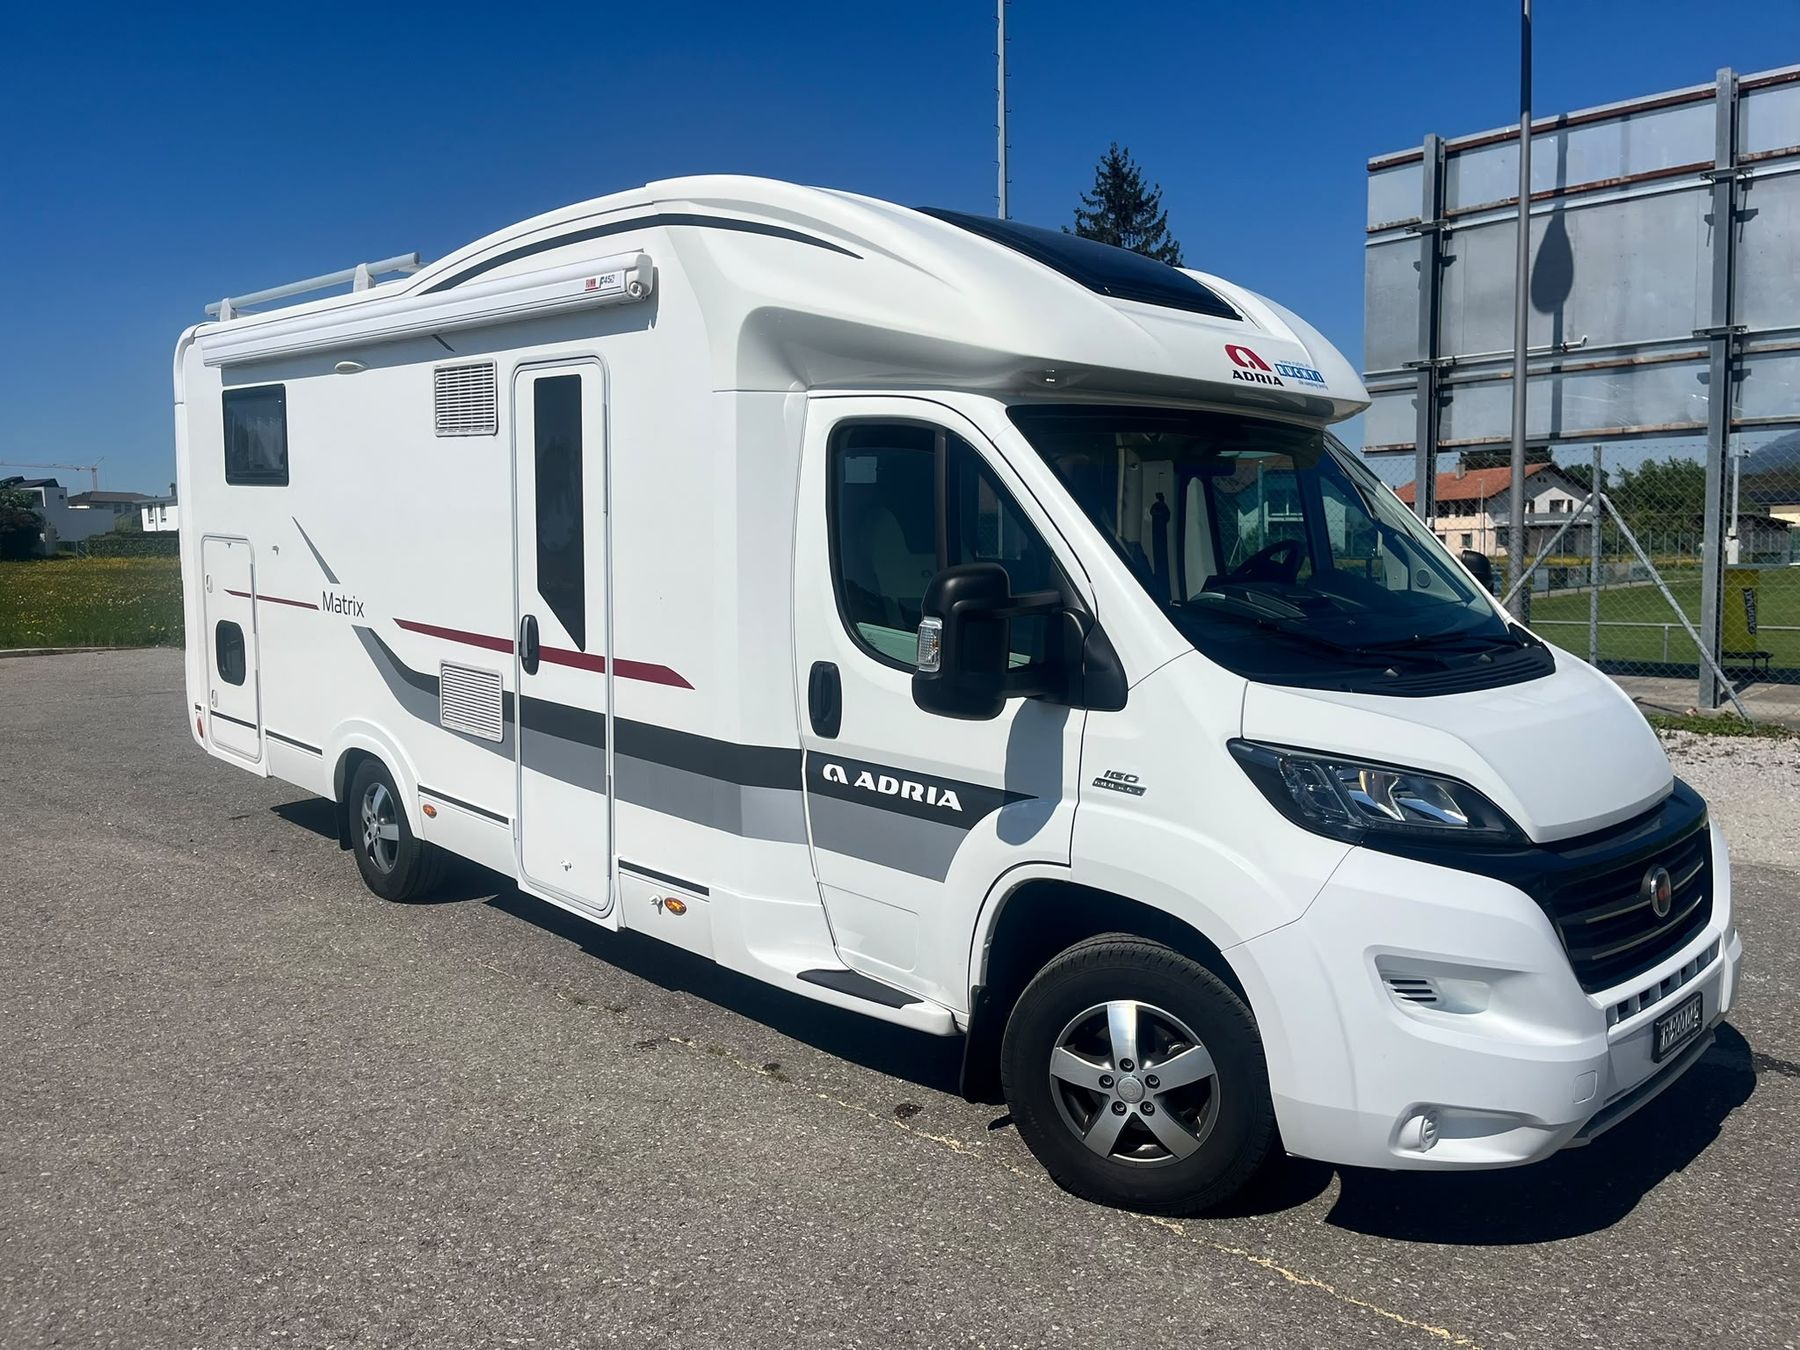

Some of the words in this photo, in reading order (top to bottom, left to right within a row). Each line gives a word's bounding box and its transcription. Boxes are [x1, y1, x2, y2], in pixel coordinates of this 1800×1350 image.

[1232, 369, 1285, 387] ADRIA
[322, 590, 365, 618] Matrix
[853, 770, 963, 812] ADRIA
